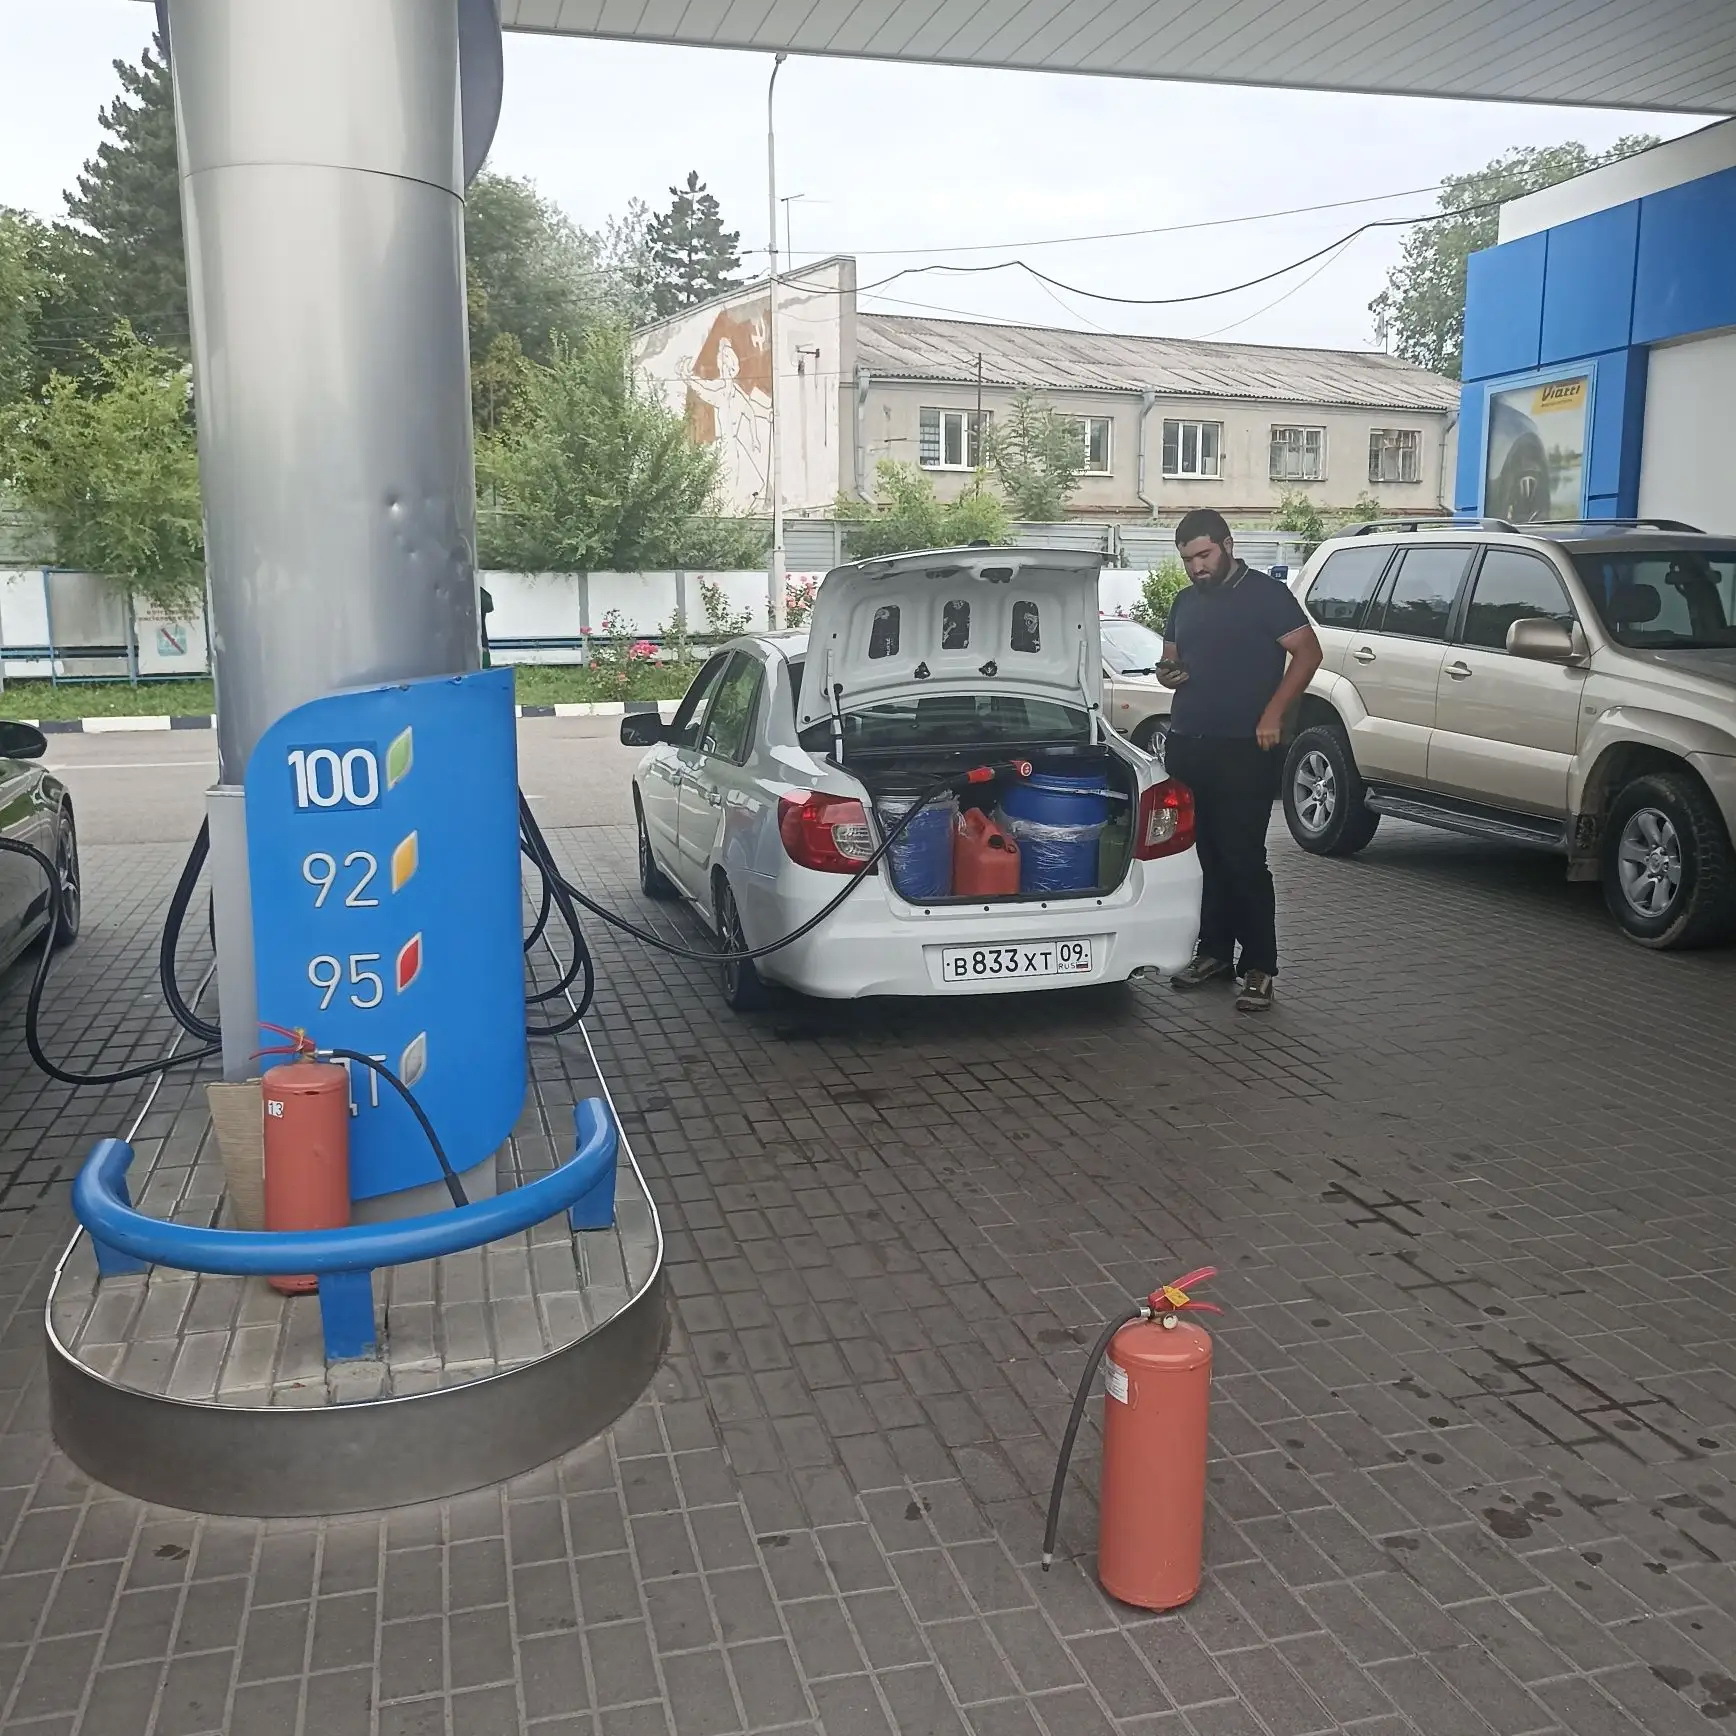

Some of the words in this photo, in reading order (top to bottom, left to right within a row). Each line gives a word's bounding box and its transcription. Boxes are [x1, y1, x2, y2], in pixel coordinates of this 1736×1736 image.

[287, 748, 379, 807] 100
[302, 852, 379, 908] 92
[1060, 943, 1083, 962] 09
[308, 953, 383, 1010] 95
[269, 1102, 283, 1116] 13
